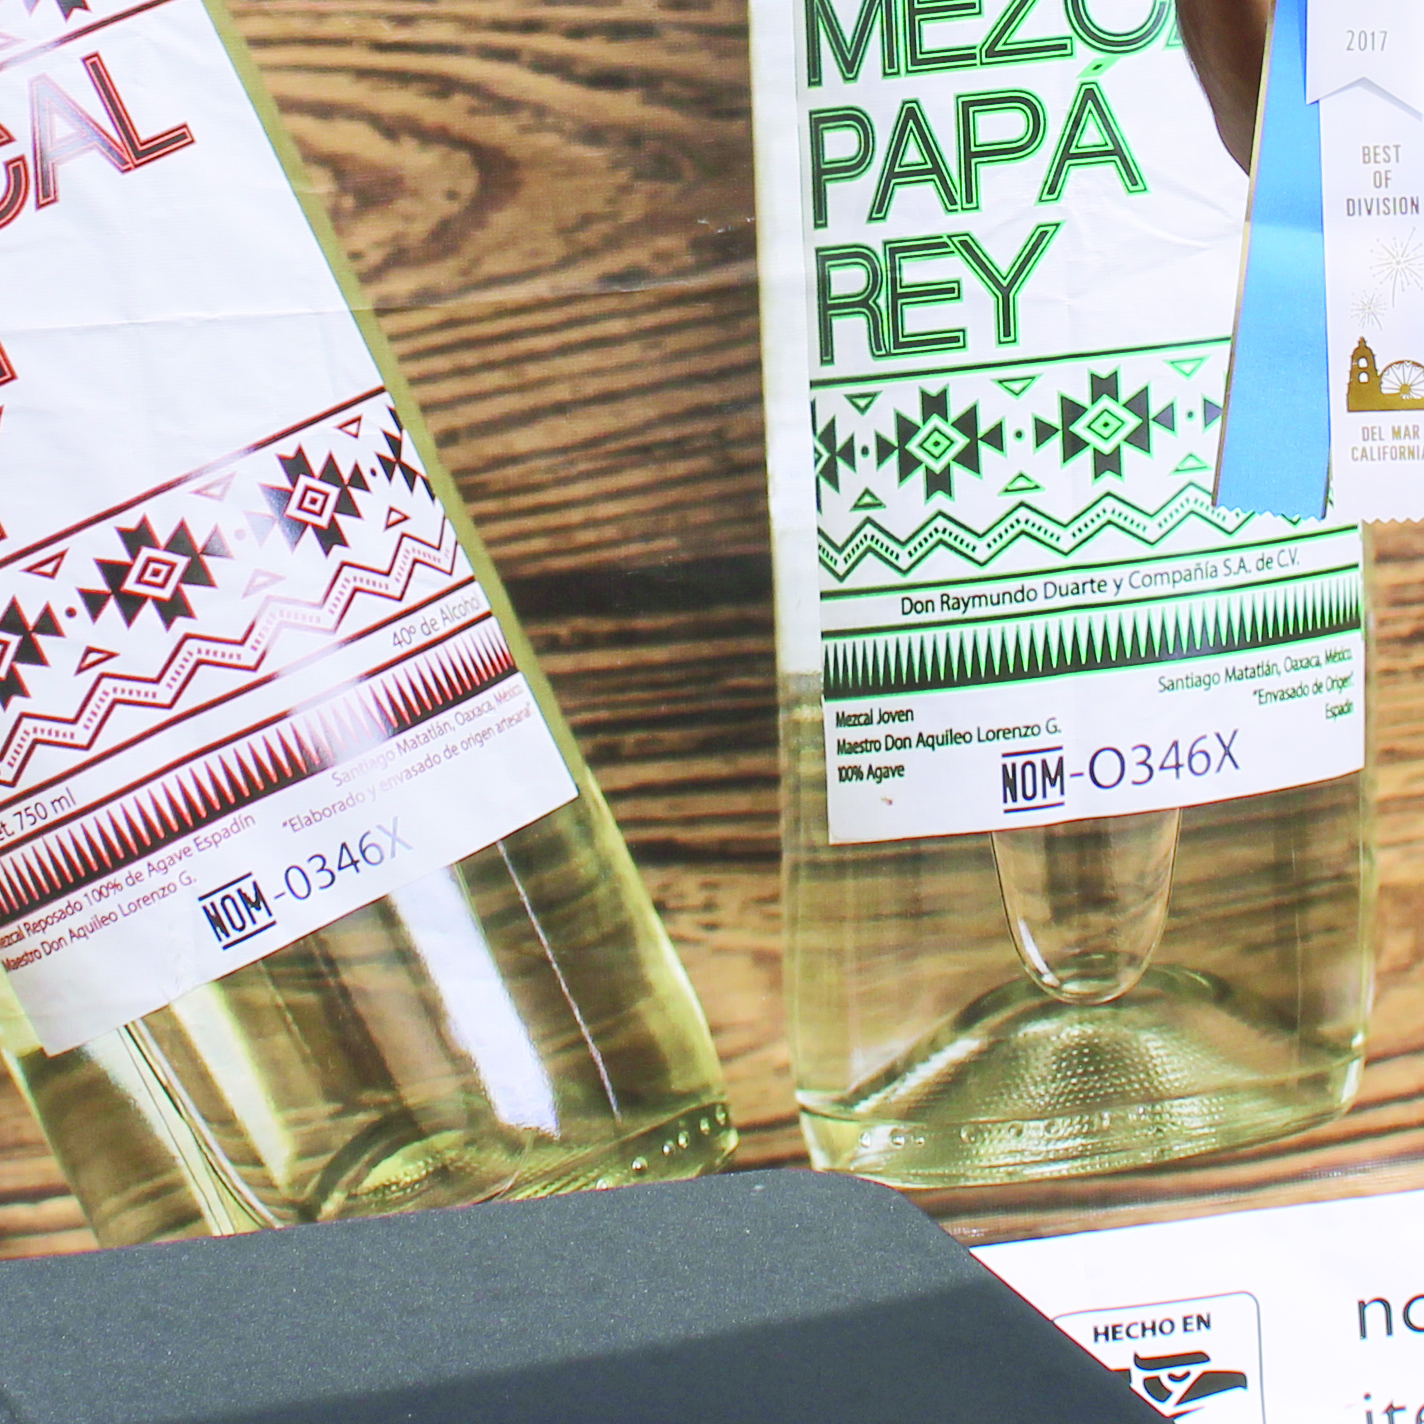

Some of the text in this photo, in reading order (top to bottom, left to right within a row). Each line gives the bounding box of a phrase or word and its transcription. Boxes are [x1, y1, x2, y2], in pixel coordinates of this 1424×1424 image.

[1345, 29, 1388, 53] 2017
[807, 55, 1150, 229] PAPÁ
[1362, 144, 1402, 165] BEST
[1372, 169, 1393, 190] OF
[1345, 195, 1421, 217] DIVISION
[813, 219, 1065, 366] REY
[1361, 423, 1421, 442] DEL MAR
[900, 547, 1301, 617] Don Raymundo Duarte y Compañía S.A. de C.V.
[420, 615, 439, 637] de
[1158, 672, 1221, 694] Santiago
[1224, 659, 1282, 684] Matatlán,
[1283, 654, 1323, 674] Oaxaca,
[1311, 678, 1324, 694] de
[835, 707, 914, 728] Mezcal Joven
[331, 743, 396, 788] Santiago
[395, 721, 456, 757] Matatlán,
[454, 699, 495, 727] Oaxaca,
[836, 717, 1062, 756] Maestro Don Aquileo Lorenzo G.
[365, 784, 377, 802] y
[379, 752, 442, 792] envasado
[443, 742, 460, 761] de
[459, 725, 497, 750] origen
[837, 763, 905, 784] 100% Agave
[13, 800, 49, 831] 750
[49, 786, 78, 819] ml
[22, 900, 83, 943] Reposado
[83, 878, 124, 907] 100%
[125, 864, 145, 888] de
[146, 844, 193, 879] Agave
[192, 812, 257, 853] Espadín
[1, 870, 198, 973] Maestro Don Aquileo Lorenzo G.
[1092, 1312, 1211, 1343] HECHO EN
